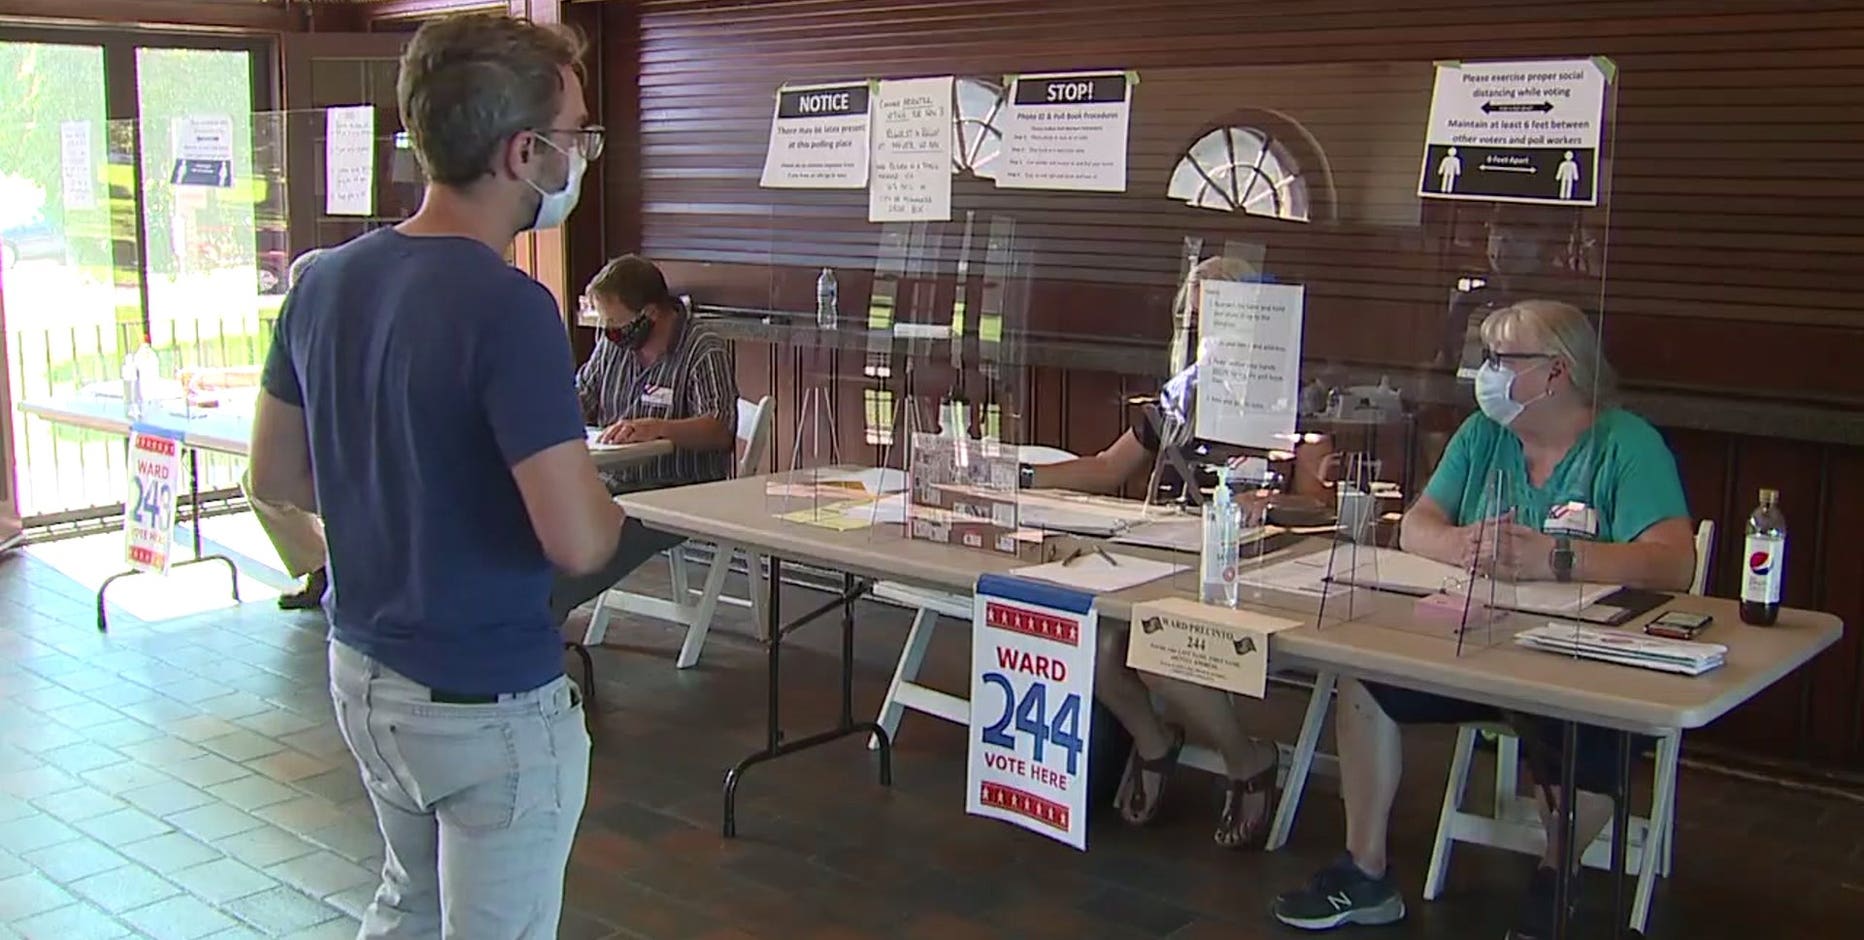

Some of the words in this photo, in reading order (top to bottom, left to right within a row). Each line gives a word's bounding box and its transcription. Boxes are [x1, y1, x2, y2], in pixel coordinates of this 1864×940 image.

[1463, 73, 1489, 82] Please
[1491, 73, 1524, 81] exercise
[1527, 73, 1556, 83] proper
[1559, 71, 1584, 80] social
[1047, 81, 1094, 101] STOP!
[1473, 88, 1516, 98] distancing
[1518, 87, 1540, 96] while
[1543, 87, 1571, 98] voting
[799, 93, 849, 112] NOTICE
[1067, 112, 1082, 120] Book
[799, 126, 812, 134] may
[1448, 120, 1488, 129] Maintain
[1501, 120, 1522, 129] least
[1524, 120, 1530, 129] 6
[1531, 120, 1549, 129] feet
[1551, 120, 1590, 129] between
[788, 141, 795, 149] at
[811, 140, 834, 149] polling
[835, 141, 852, 149] place
[1452, 135, 1477, 143] other
[1479, 136, 1507, 144] voters
[1509, 136, 1526, 144] and
[1527, 136, 1544, 145] poll
[1546, 136, 1582, 144] workers
[137, 459, 169, 479] WARD
[133, 475, 171, 531] 243
[1162, 617, 1188, 630] WARD
[1187, 636, 1206, 651] 244
[996, 646, 1066, 682] WARD
[982, 672, 1083, 776] 244
[985, 752, 1026, 776] VOTE
[1031, 764, 1067, 791] HERE
